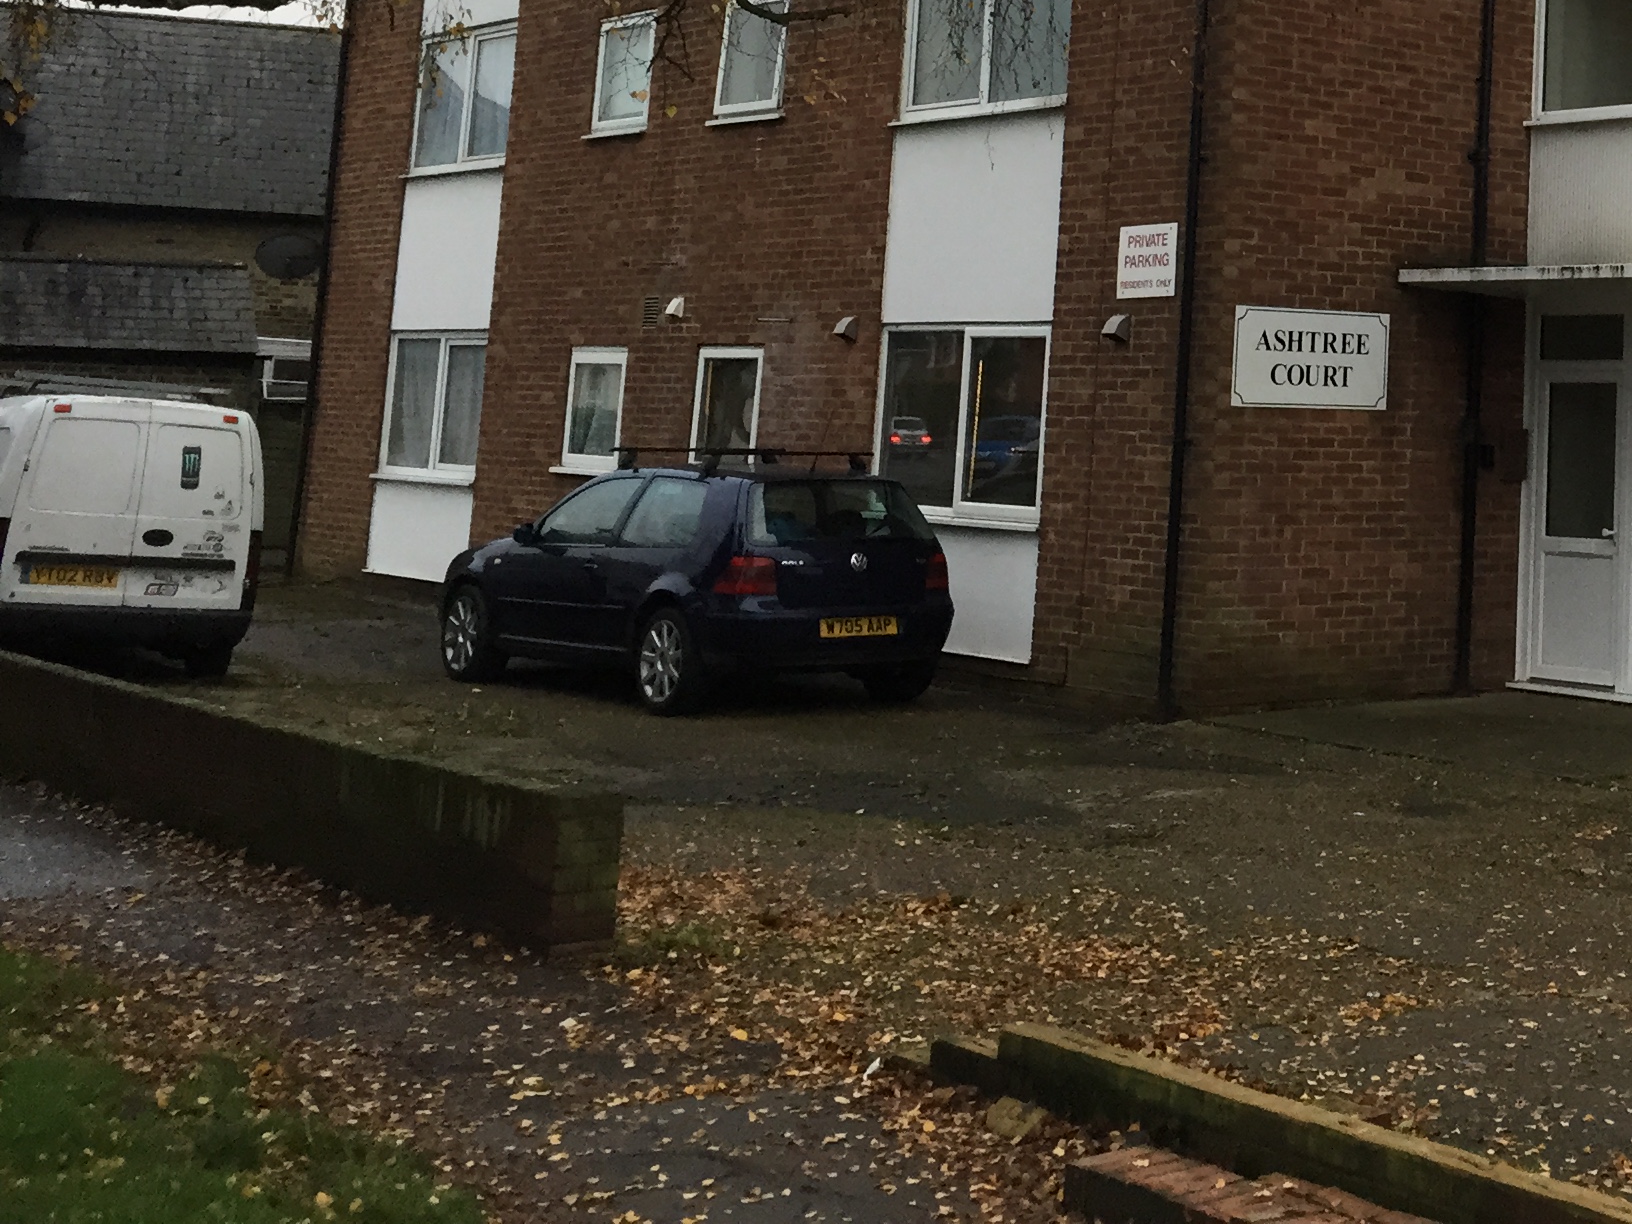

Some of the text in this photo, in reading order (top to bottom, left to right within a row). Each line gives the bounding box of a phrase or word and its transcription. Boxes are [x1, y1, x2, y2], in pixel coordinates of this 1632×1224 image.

[1128, 233, 1169, 248] PRIVATE
[1124, 252, 1170, 268] PARKING
[1120, 278, 1172, 289] RESIDENTS ONLY
[1255, 329, 1370, 355] ASHTREE
[1270, 363, 1353, 388] COURT
[867, 617, 892, 633] AAP
